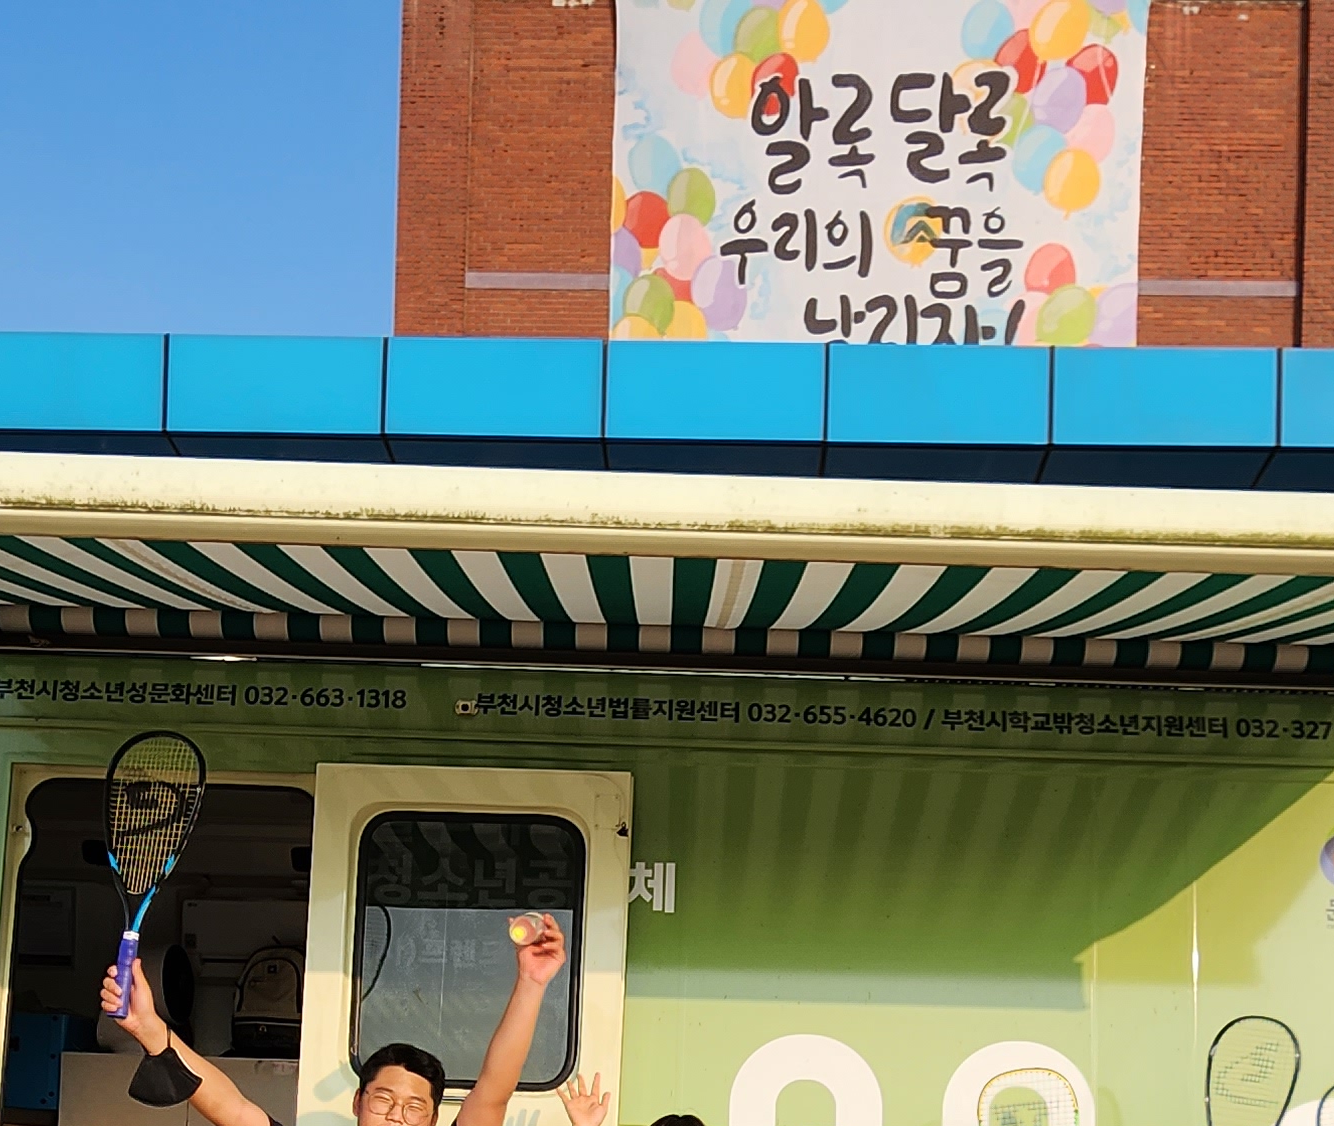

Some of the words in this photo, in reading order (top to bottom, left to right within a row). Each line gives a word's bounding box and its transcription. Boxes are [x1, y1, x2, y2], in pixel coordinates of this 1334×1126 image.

[751, 72, 875, 194] 알록
[889, 70, 1011, 191] 달록
[720, 199, 874, 285] 우리의
[890, 203, 1023, 299] 꿈을
[475, 693, 741, 725] 부천시청소년법률지원센터
[941, 708, 1228, 740] 부천시학교밖청소년지원센터
